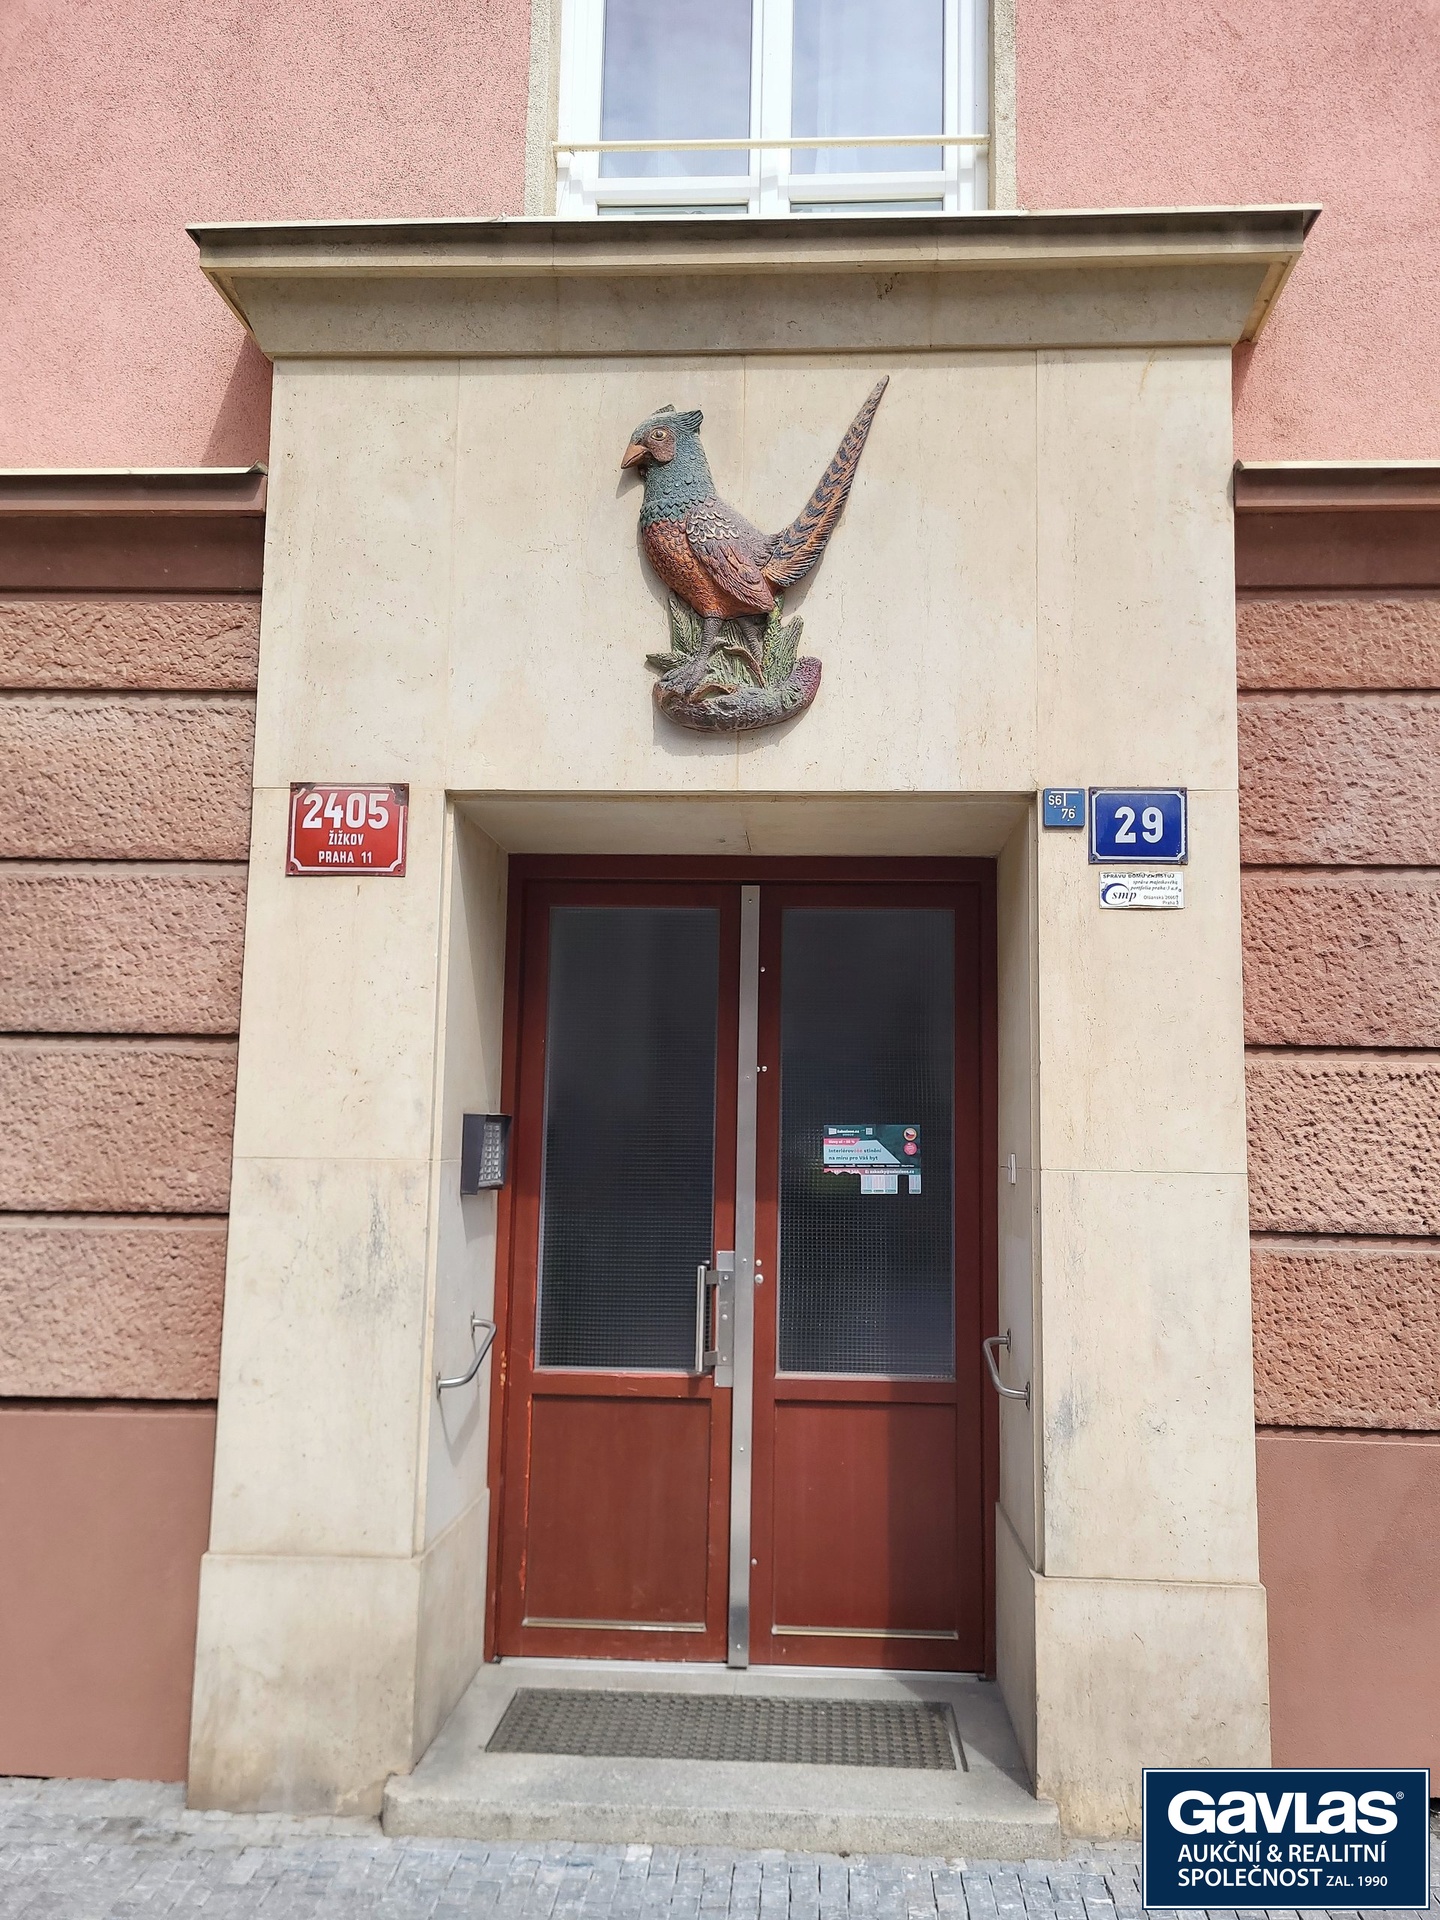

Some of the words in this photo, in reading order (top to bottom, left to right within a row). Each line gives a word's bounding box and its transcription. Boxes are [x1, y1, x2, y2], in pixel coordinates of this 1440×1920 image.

[302, 792, 389, 829] 2405
[1061, 808, 1076, 819] 76
[1114, 806, 1164, 844] 29
[328, 830, 365, 846] ŽIŽKOV
[318, 850, 355, 864] PRAHA
[361, 851, 372, 864] 11
[1112, 892, 1137, 902] smp
